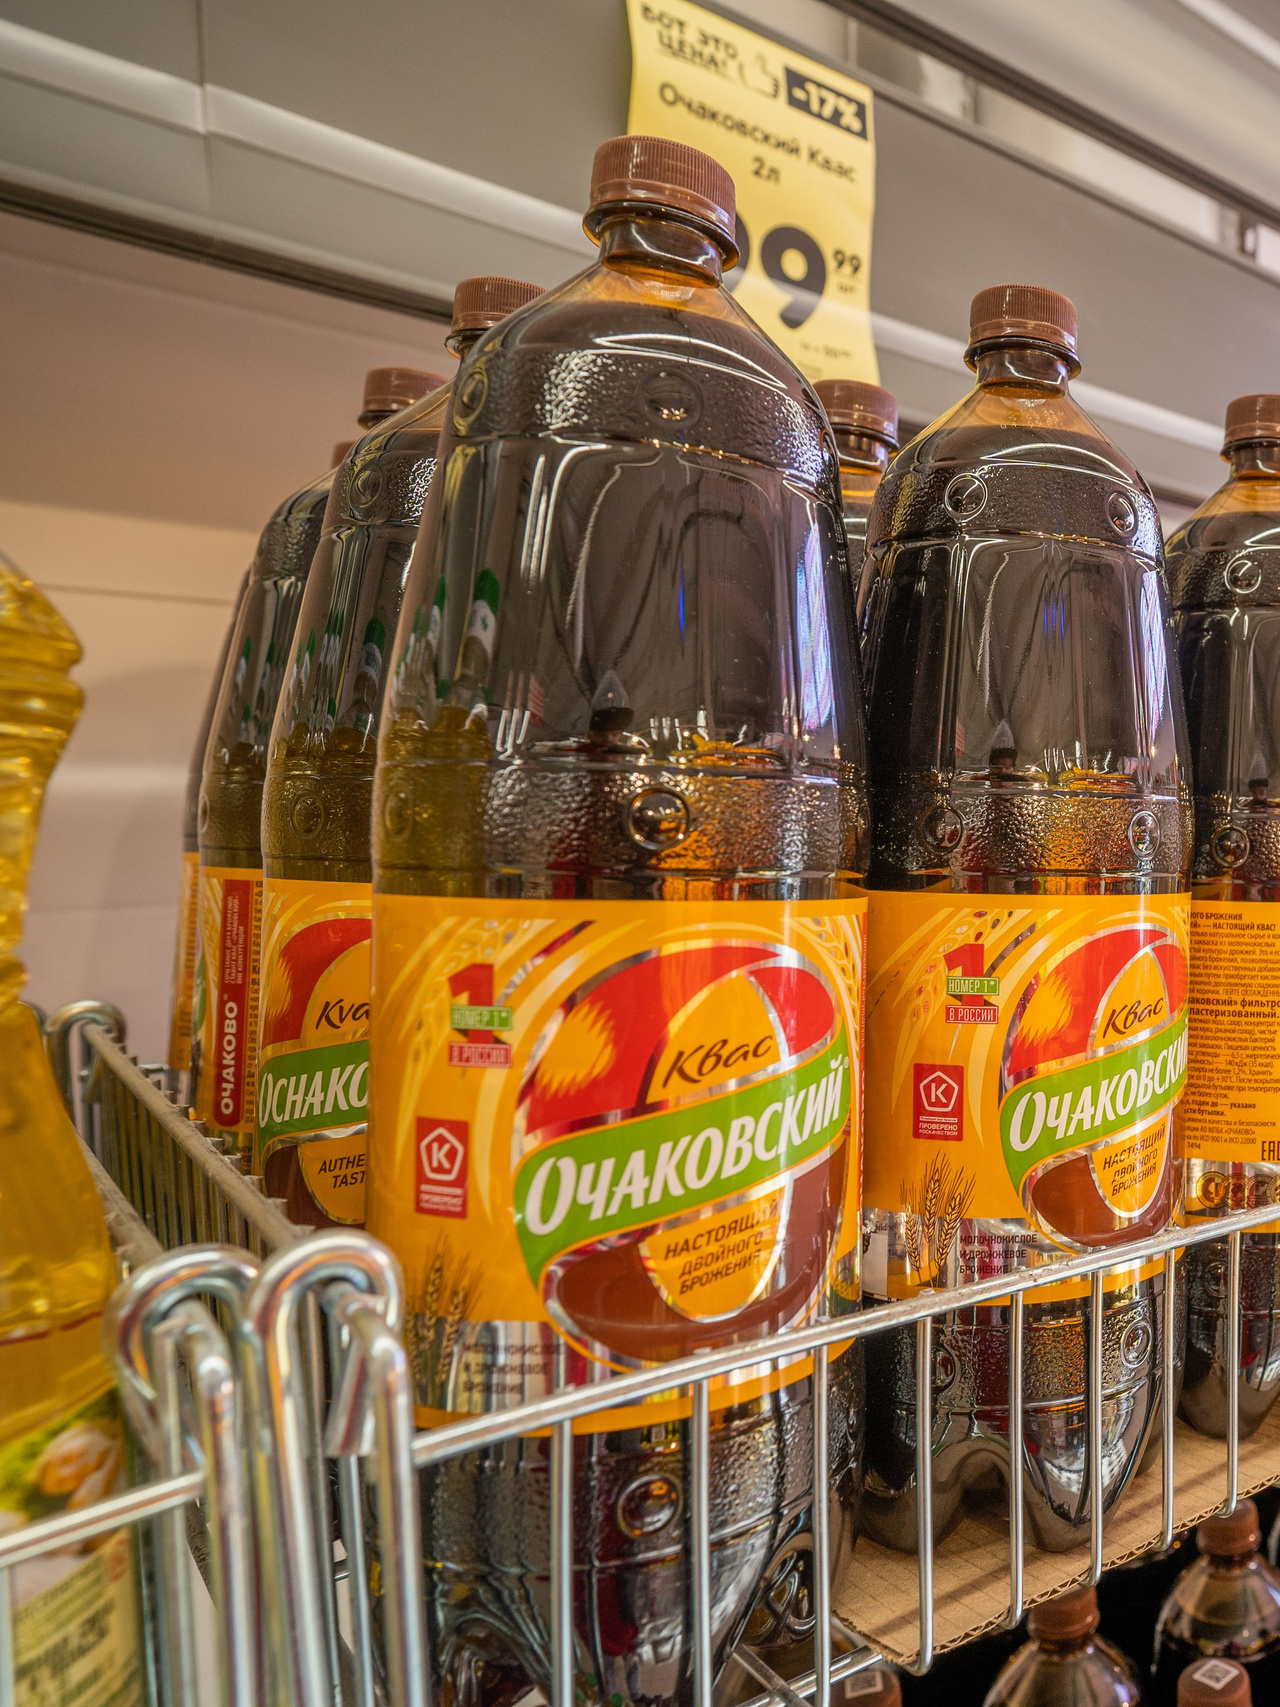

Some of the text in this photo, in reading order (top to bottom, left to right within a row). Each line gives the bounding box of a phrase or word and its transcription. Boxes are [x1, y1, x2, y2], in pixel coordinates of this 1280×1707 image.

[698, 30, 738, 60] ЭТО
[791, 80, 863, 133] -17%
[659, 82, 858, 183] Очаковский Квас
[752, 156, 781, 184] 2л
[833, 250, 861, 275] 99
[1205, 912, 1242, 921] БРОЖЕНИЯ
[1212, 922, 1276, 931] НАСТОЯЩИЙ КВАС!
[943, 944, 984, 1006] 1
[949, 979, 980, 993] НОМЕР
[315, 998, 370, 1030] Kva
[448, 963, 494, 1043] 1
[949, 1008, 994, 1022] В РОССИИ
[1102, 997, 1163, 1039] Квас
[220, 1001, 238, 1115] ОЧАКОВО
[662, 1034, 773, 1089] Квас
[258, 1060, 370, 1129] OCHAKO
[931, 1082, 948, 1103] К
[919, 1123, 958, 1131] ПРОВЕРЕНО
[525, 1053, 843, 1235] ОЧАКОВСКИЙ
[1103, 1123, 1166, 1171] НАСТОЯЩИЙ
[318, 1153, 366, 1175] AUTHE
[332, 1170, 366, 1189] TAST
[1111, 1148, 1158, 1185] ДВОЙНОГО
[1112, 1162, 1157, 1197] БРОЖЕНИЯ
[664, 1198, 780, 1260] НАСТОЯЩИЙ
[959, 1233, 1038, 1244] МОЛОЧНОКИСЛОЕ
[678, 1231, 764, 1280] ДВОЙНОГО
[959, 1265, 1009, 1274] БРОЖЕНИЕ
[969, 1250, 1027, 1259] ДРОЖЖЕВОЕ
[679, 1248, 762, 1295] БРОЖЕНИЯ
